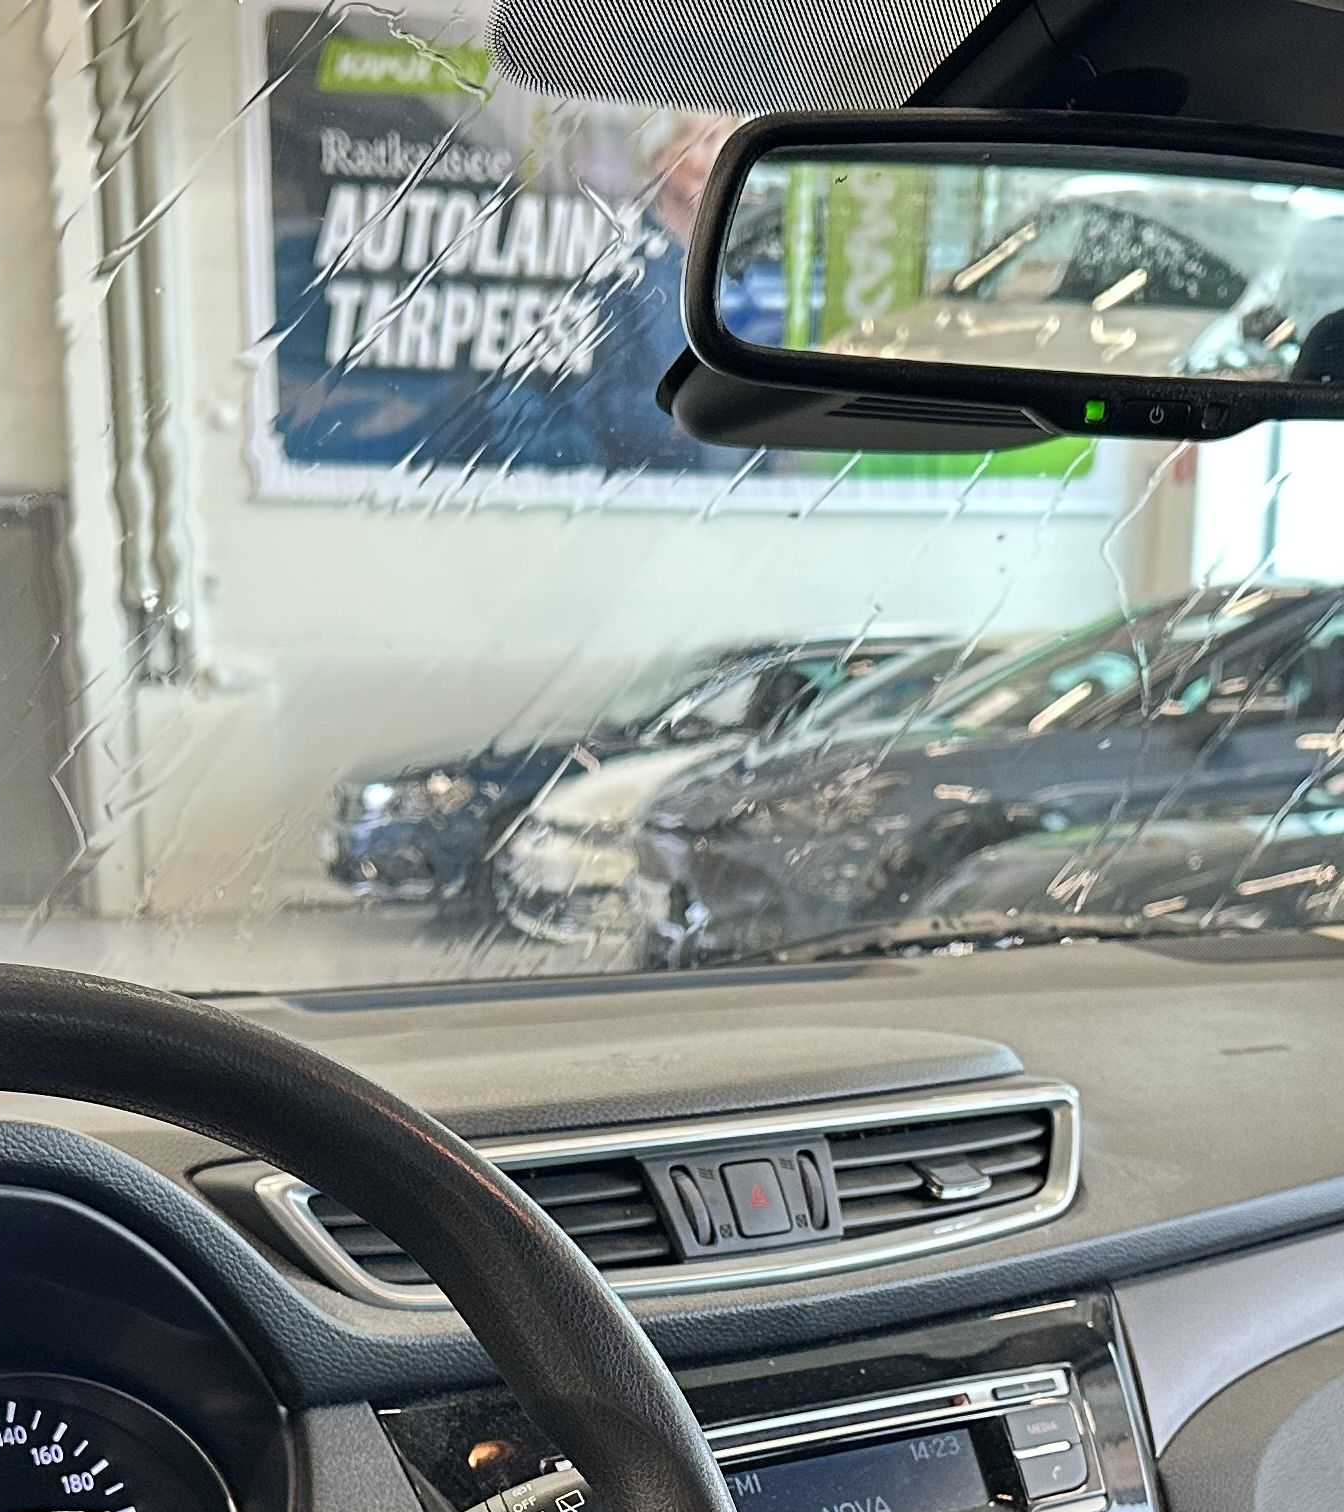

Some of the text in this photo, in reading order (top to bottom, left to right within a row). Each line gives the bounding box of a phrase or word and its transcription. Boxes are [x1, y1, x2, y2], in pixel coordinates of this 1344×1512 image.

[30, 1444, 64, 1466] 160
[908, 1435, 960, 1461] 14:23
[60, 1471, 94, 1494] 180
